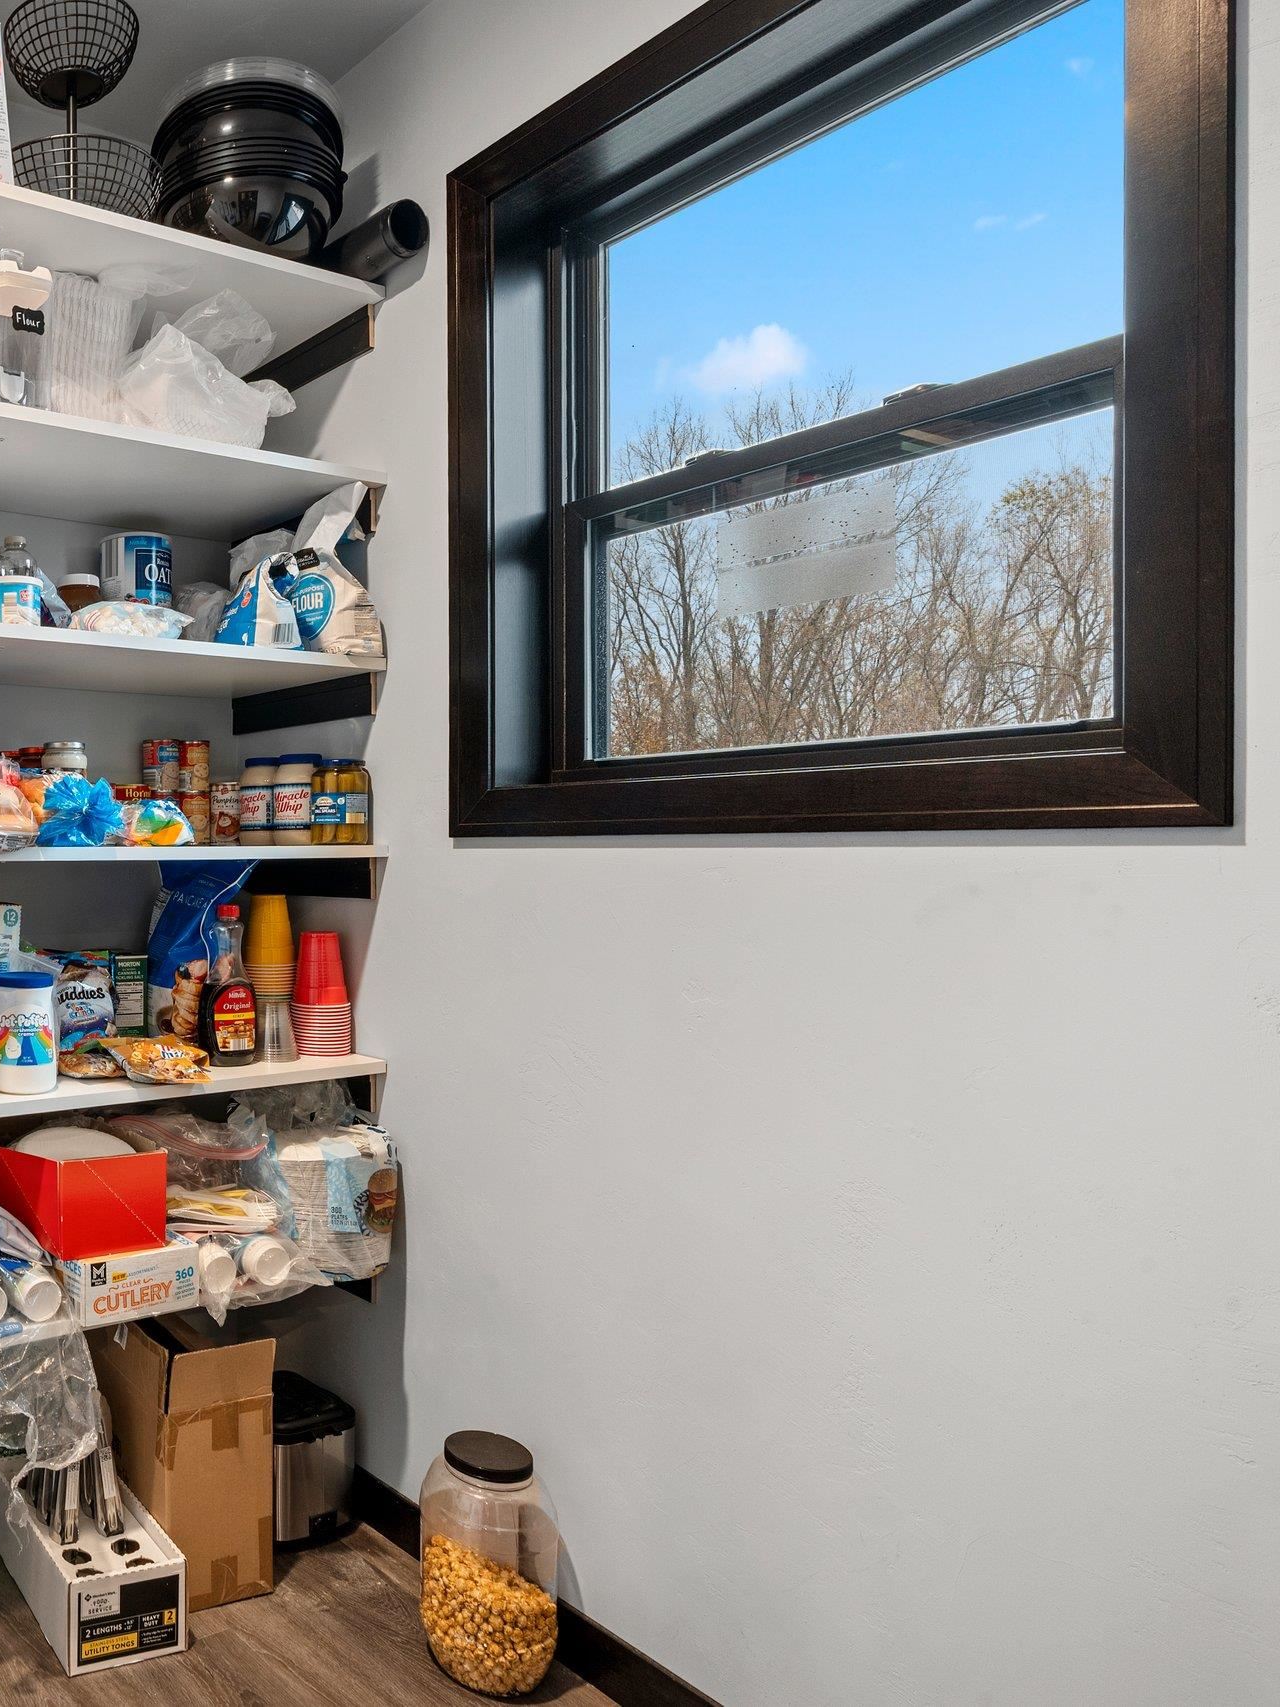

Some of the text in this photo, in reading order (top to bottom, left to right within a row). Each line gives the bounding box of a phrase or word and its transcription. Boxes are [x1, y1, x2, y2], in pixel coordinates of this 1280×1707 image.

[15, 311, 41, 329] Flour
[292, 593, 324, 614] FLOUR
[211, 795, 239, 805] Pumpkin
[275, 789, 310, 801] Miracle
[276, 802, 303, 814] Whip
[5, 910, 17, 921] 12
[222, 1000, 252, 1011] Original
[112, 1272, 127, 1281] NEW
[175, 1265, 194, 1281] 360
[121, 1280, 141, 1289] CLEAR
[93, 1280, 173, 1315] CUTLERY
[88, 1605, 113, 1615] SERVICE
[167, 1610, 173, 1621] 2
[142, 1613, 160, 1623] HEAVY
[143, 1620, 159, 1628] DUTY
[85, 1623, 123, 1638] 2 LENGTHS
[89, 1637, 114, 1649] STAINLESS
[113, 1635, 130, 1645] STEEL
[84, 1640, 135, 1657] UTILITY TONGS
